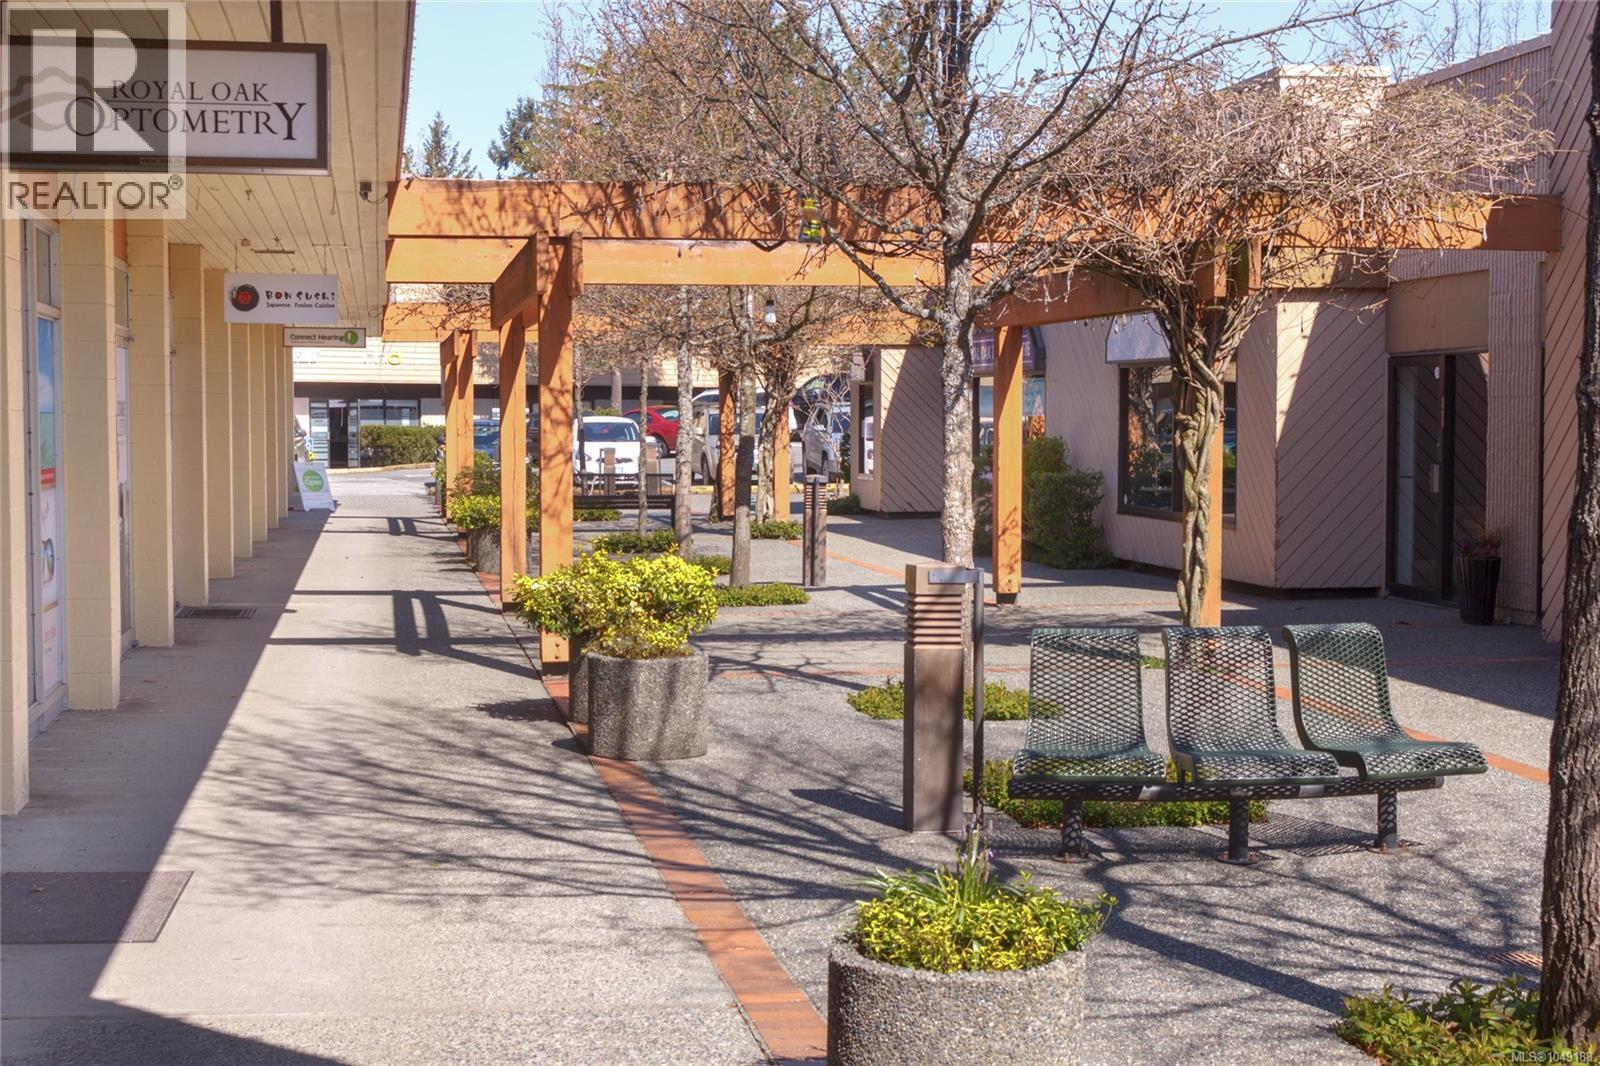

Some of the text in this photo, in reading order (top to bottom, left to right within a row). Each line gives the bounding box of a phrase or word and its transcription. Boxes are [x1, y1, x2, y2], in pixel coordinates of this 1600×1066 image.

[112, 79, 270, 102] ROYAL OAK
[64, 97, 307, 140] OPTOMETRY
[290, 333, 345, 342] Connect Hearing
